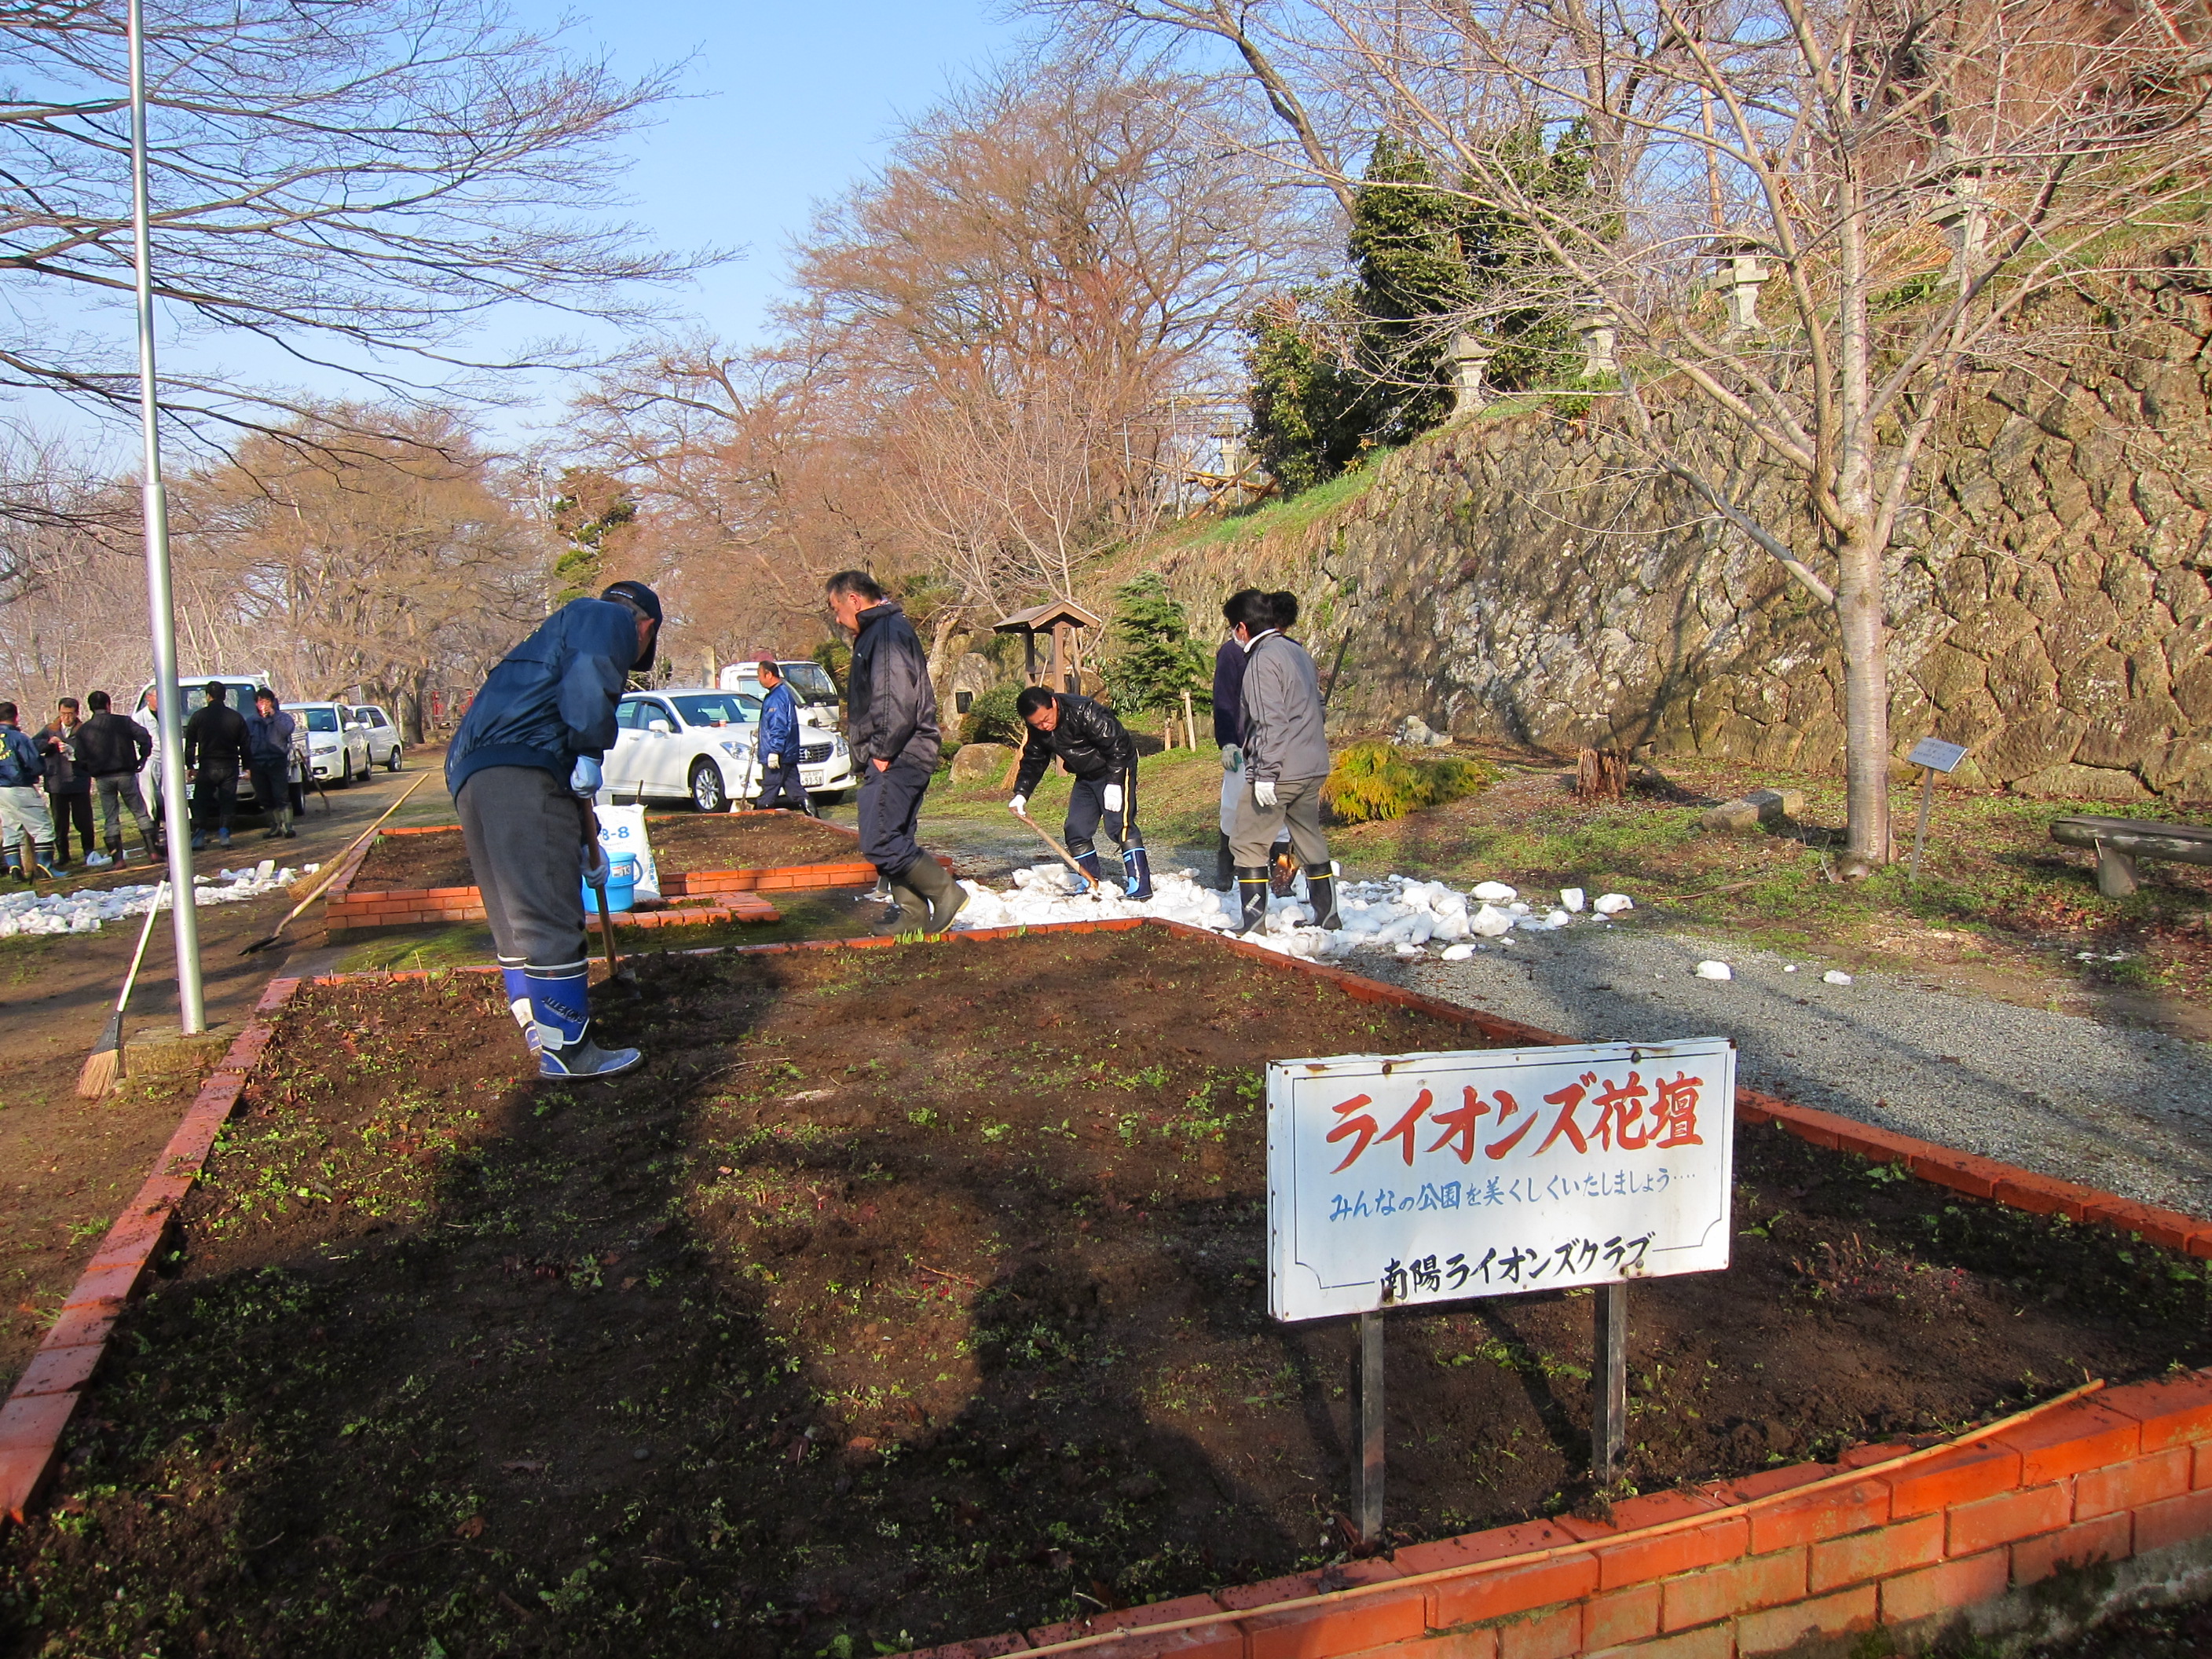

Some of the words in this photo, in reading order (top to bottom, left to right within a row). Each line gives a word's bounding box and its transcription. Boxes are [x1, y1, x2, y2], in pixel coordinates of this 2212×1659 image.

[1326, 1071, 1704, 1175] ライオンズ花壇
[1380, 1230, 1657, 1301] 南陽ライオンズクラブ
